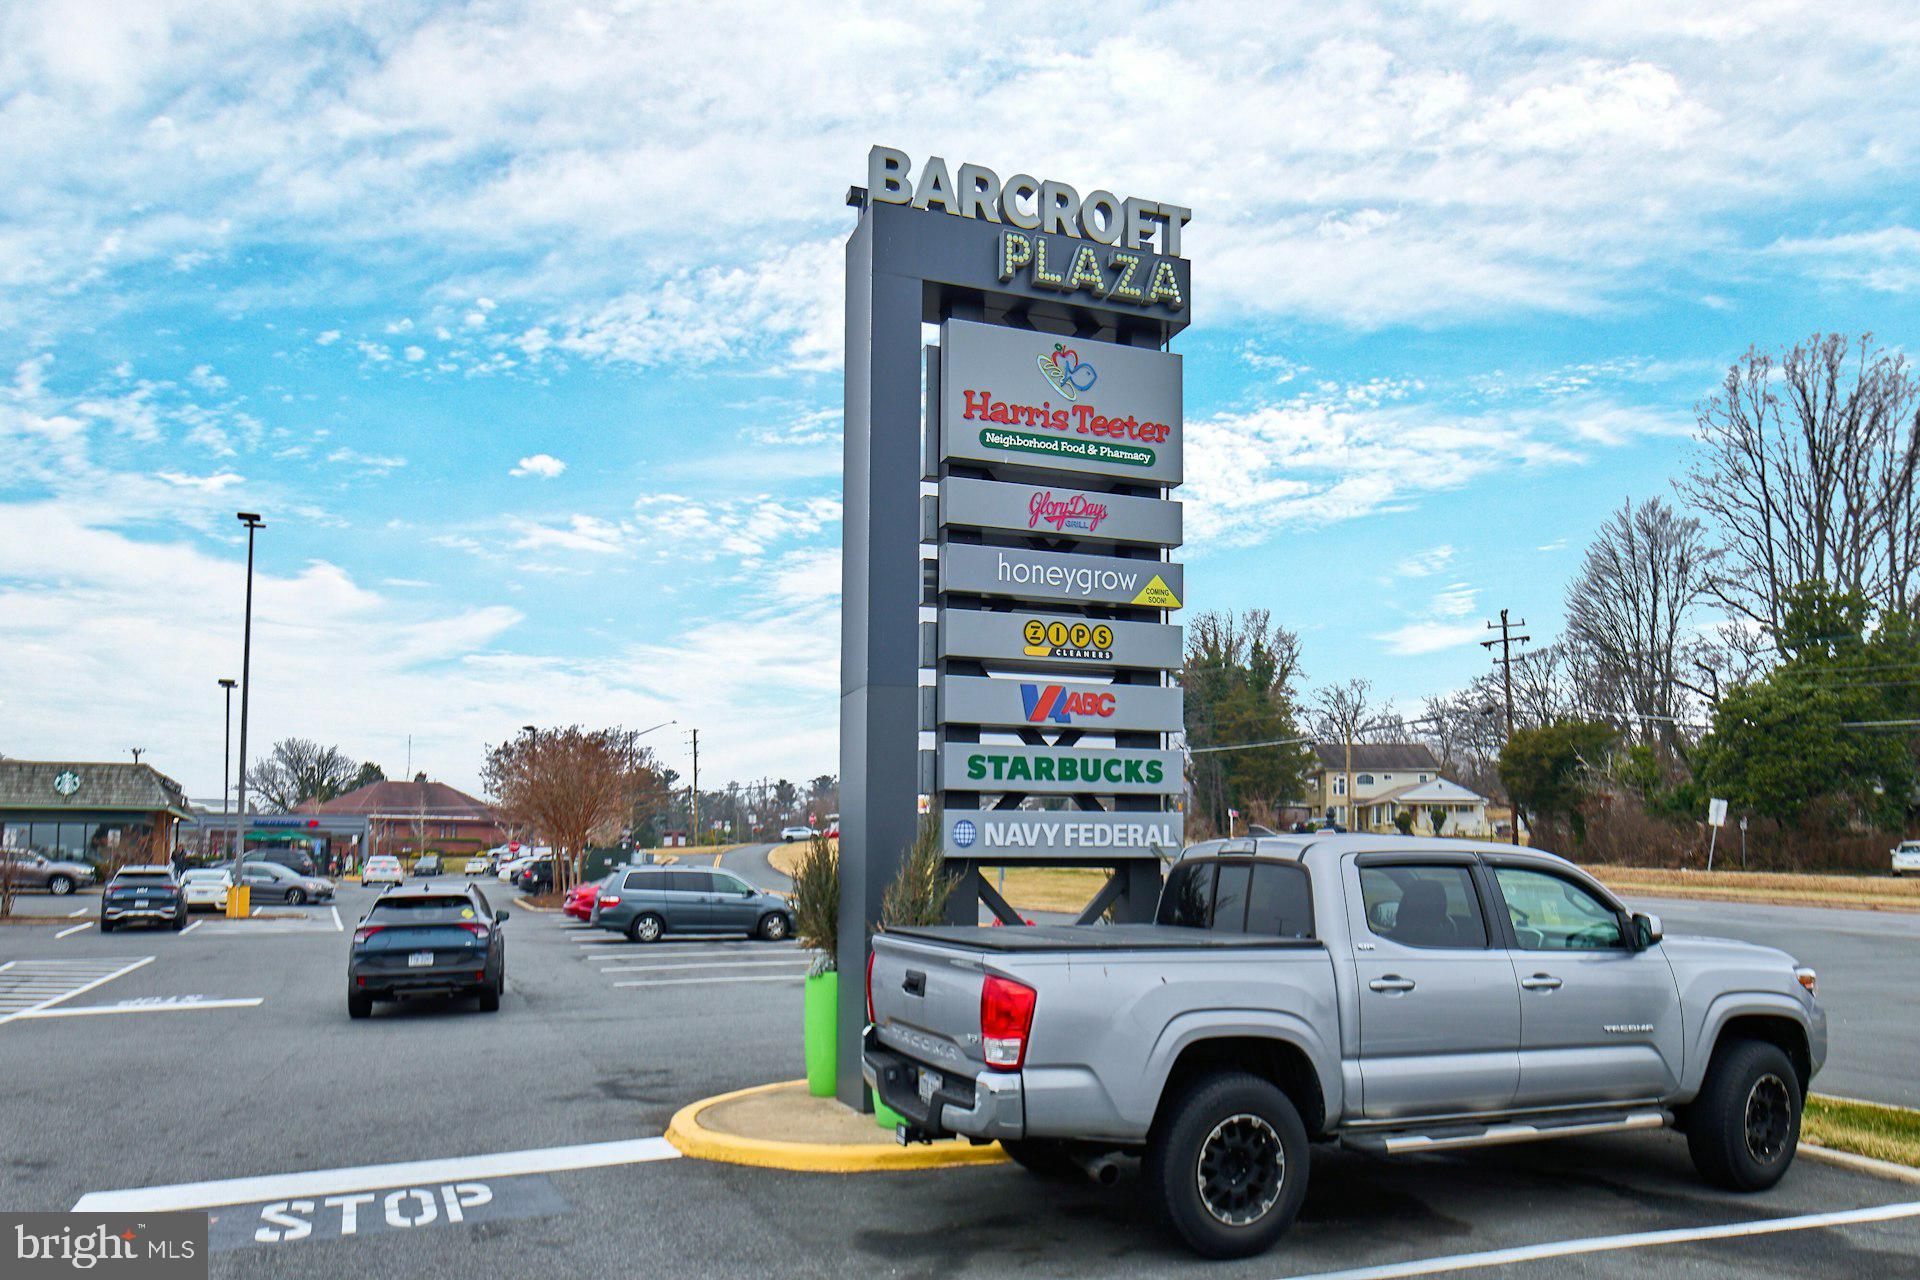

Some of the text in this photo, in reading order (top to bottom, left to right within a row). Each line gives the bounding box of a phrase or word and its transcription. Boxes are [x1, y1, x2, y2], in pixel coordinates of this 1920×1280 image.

[868, 145, 1191, 257] BARCROFT
[999, 229, 1185, 311] PLAZA
[963, 390, 1171, 443] Harris Teeter
[985, 432, 1151, 464] Neighborhood Food & Pharmacy
[1029, 491, 1108, 532] Glory Days
[1065, 520, 1089, 529] GRILL
[998, 553, 1138, 595] honeygrow
[1146, 588, 1170, 597] COMING
[1028, 624, 1108, 645] ZIPS
[1055, 648, 1110, 659] CLEANERS
[1062, 692, 1115, 717] ABC
[967, 754, 1163, 784] STARBUCKS
[984, 822, 1177, 849] NAVY FEDERAL
[254, 1183, 494, 1243] STOP
